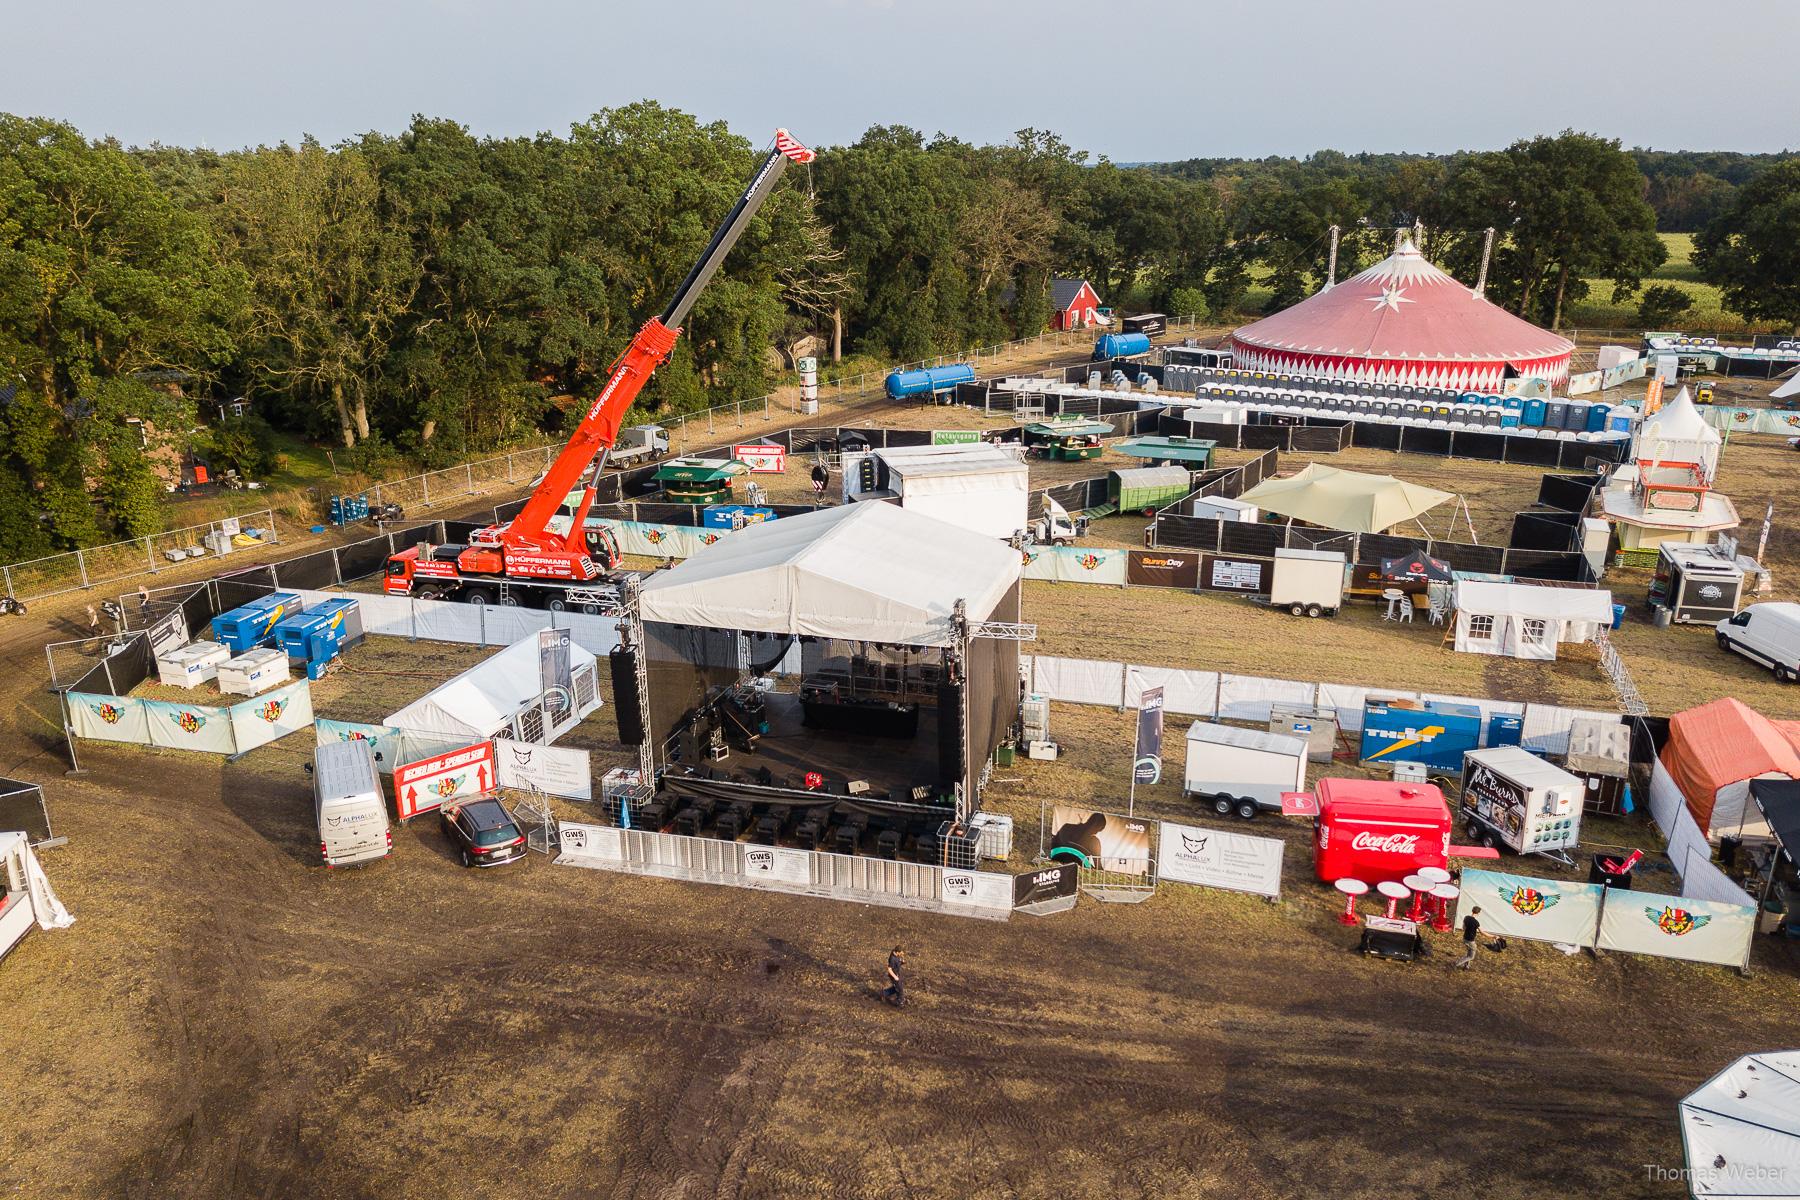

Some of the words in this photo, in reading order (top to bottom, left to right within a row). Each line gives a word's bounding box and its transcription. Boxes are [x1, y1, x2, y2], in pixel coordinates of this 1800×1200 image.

[514, 556, 571, 566] HÜFFERMANN
[343, 812, 378, 822] ALPHALUX
[1352, 831, 1420, 854] Coca-Cola
[1175, 852, 1211, 863] ALPHALUX
[948, 877, 970, 885] GWS
